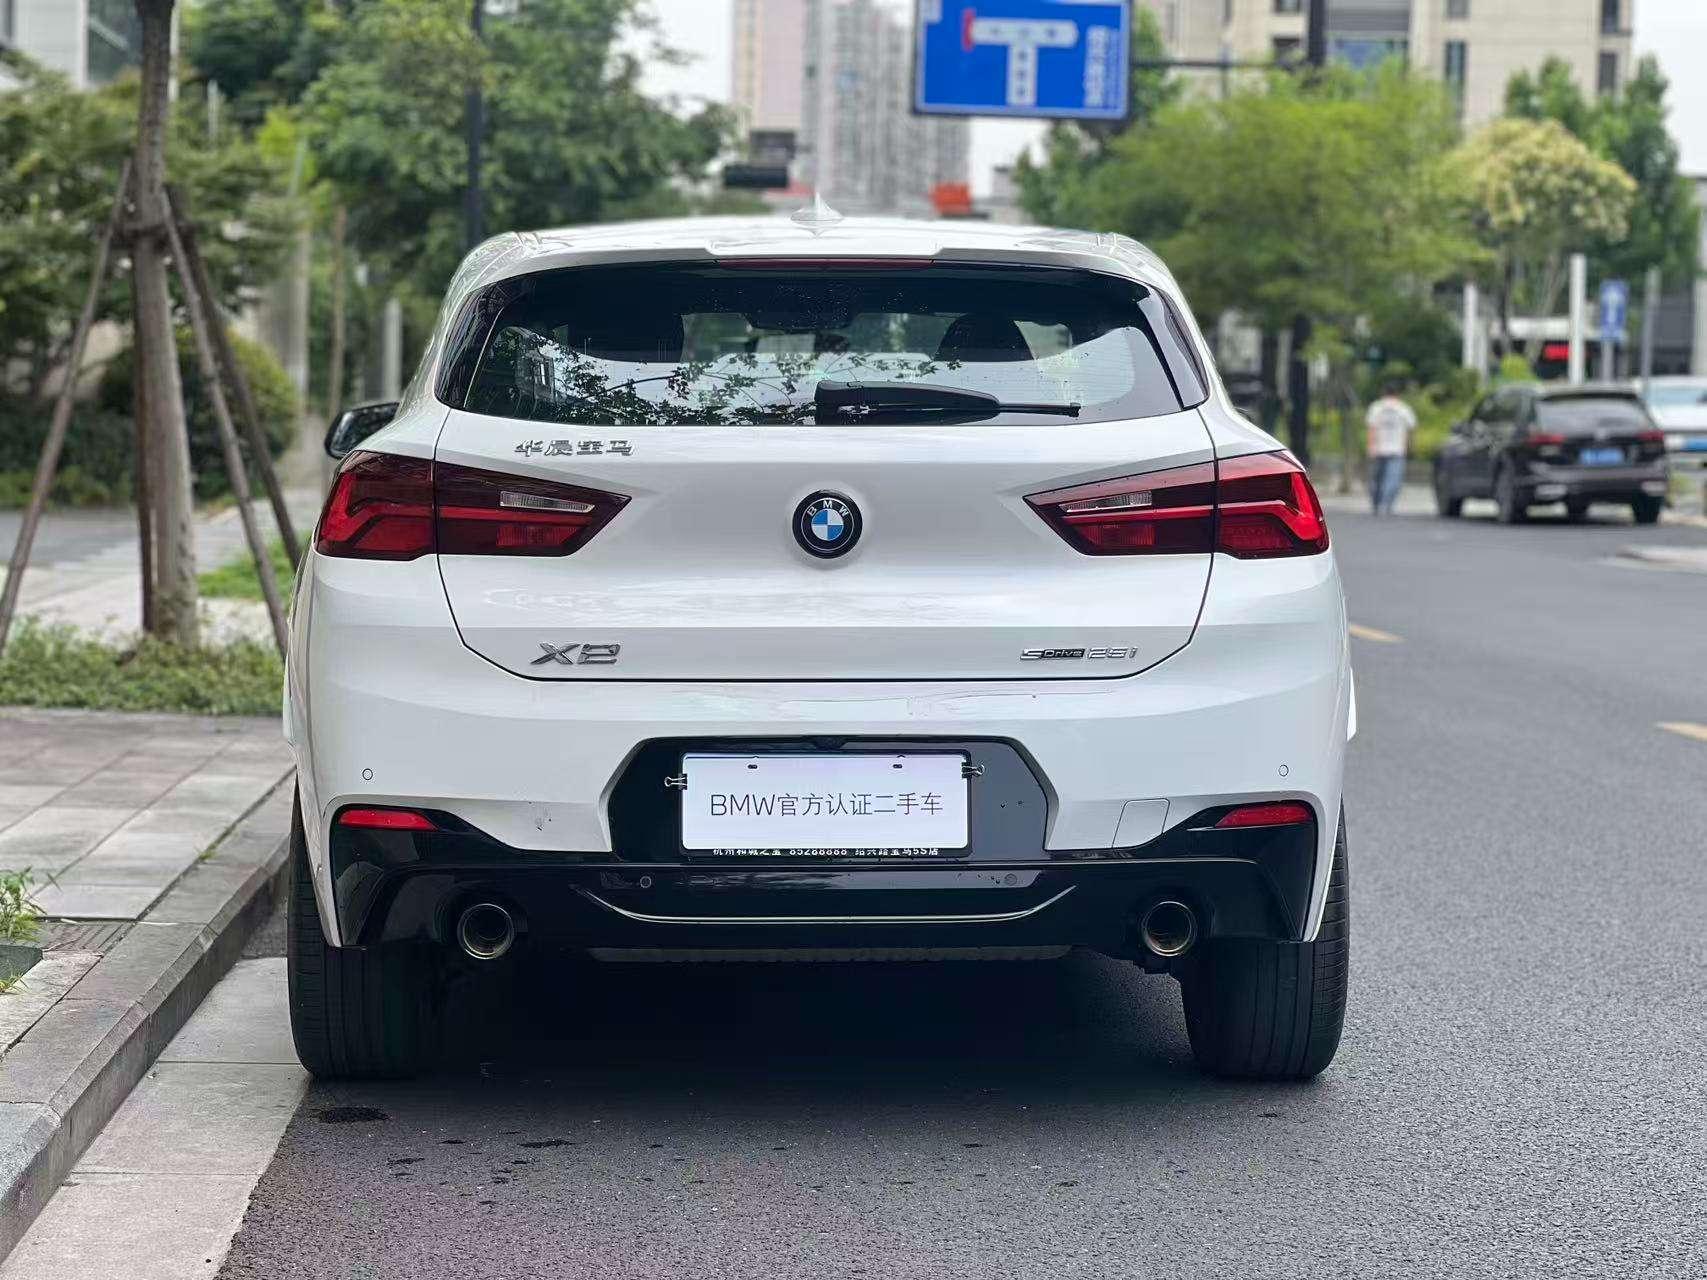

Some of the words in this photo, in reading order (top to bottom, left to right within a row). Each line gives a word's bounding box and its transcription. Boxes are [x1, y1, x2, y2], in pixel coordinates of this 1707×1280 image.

[515, 439, 634, 457] 华辰宝马
[807, 499, 850, 517] BMW
[530, 642, 621, 665] X2
[710, 792, 943, 817] BMW官方认证二手车
